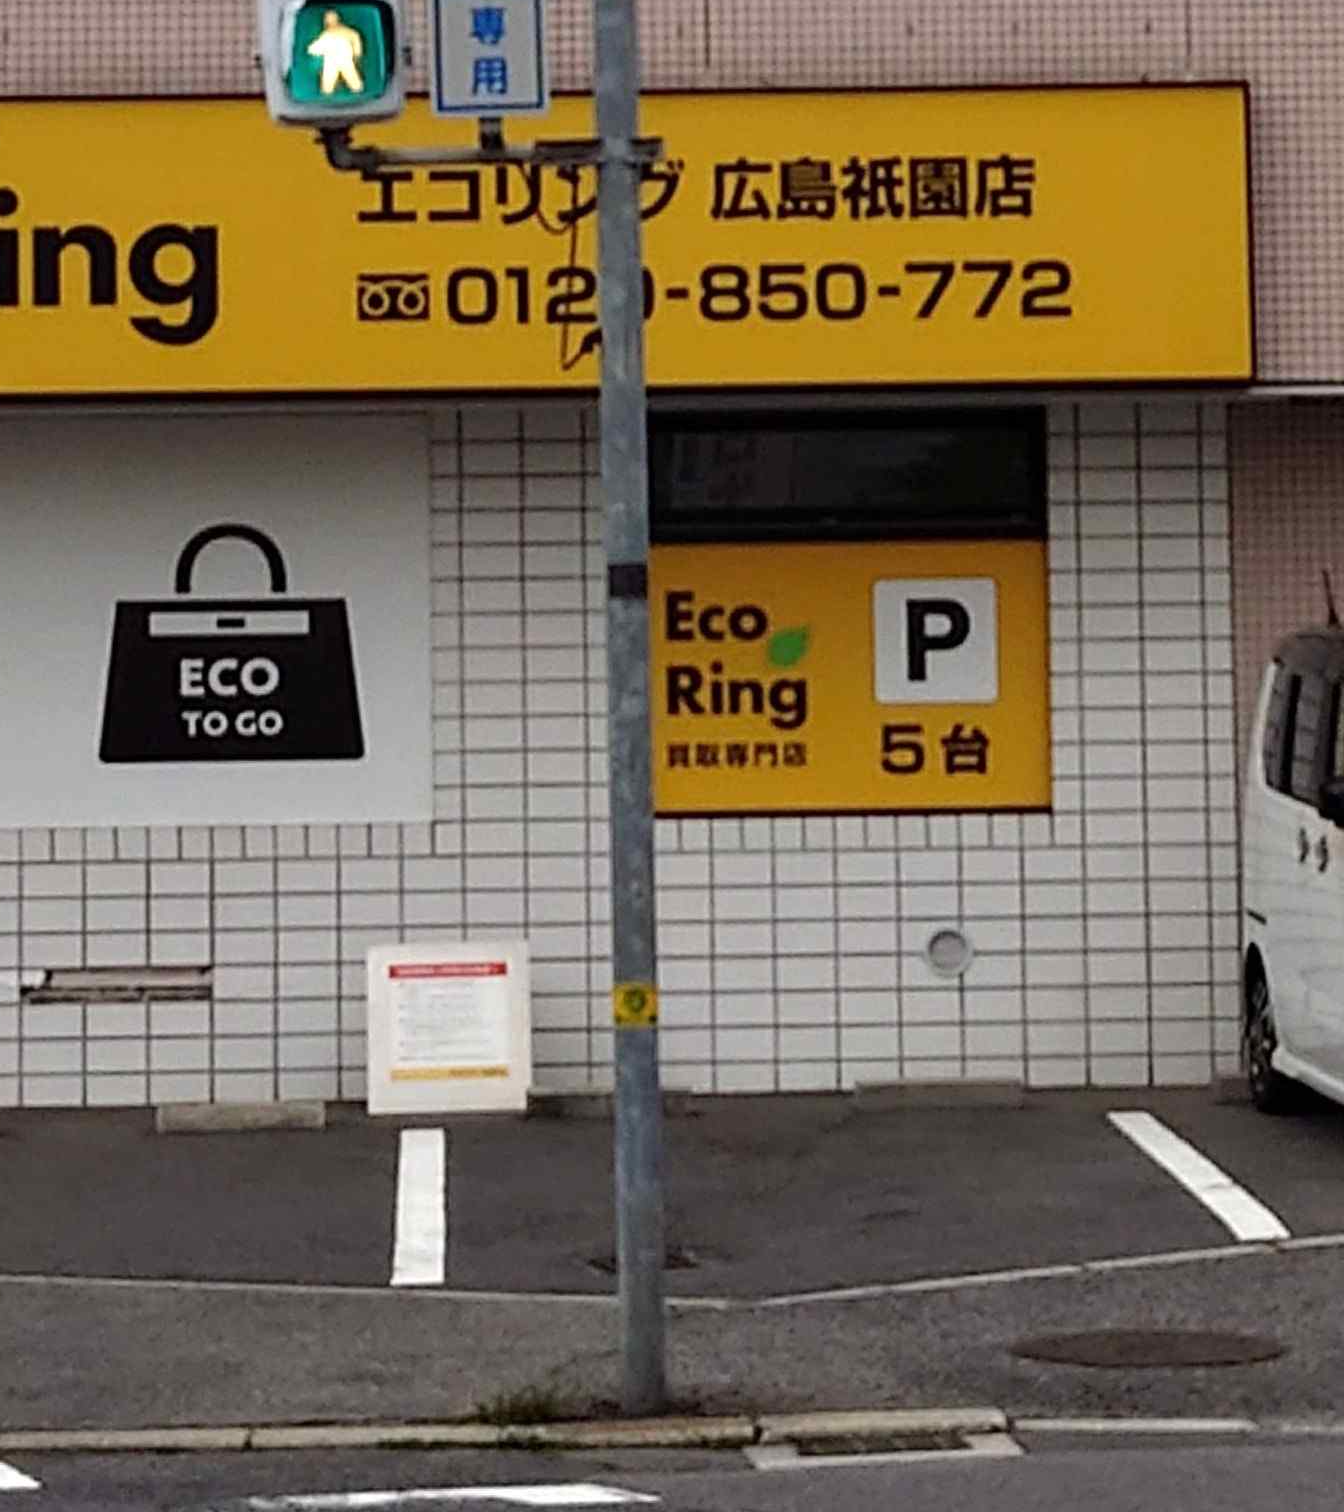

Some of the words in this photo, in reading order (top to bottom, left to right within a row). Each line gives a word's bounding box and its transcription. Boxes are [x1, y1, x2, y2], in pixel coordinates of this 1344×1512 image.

[471, 6, 508, 96] 専用
[447, 260, 1073, 326] 012-850-772
[664, 591, 769, 642] Eco
[905, 598, 971, 682] P
[179, 657, 281, 697] ECO
[665, 661, 808, 731] Ring
[181, 710, 229, 737] TO
[235, 710, 284, 737] GO
[880, 723, 990, 776] 5台
[666, 741, 808, 769] 買取専門店
